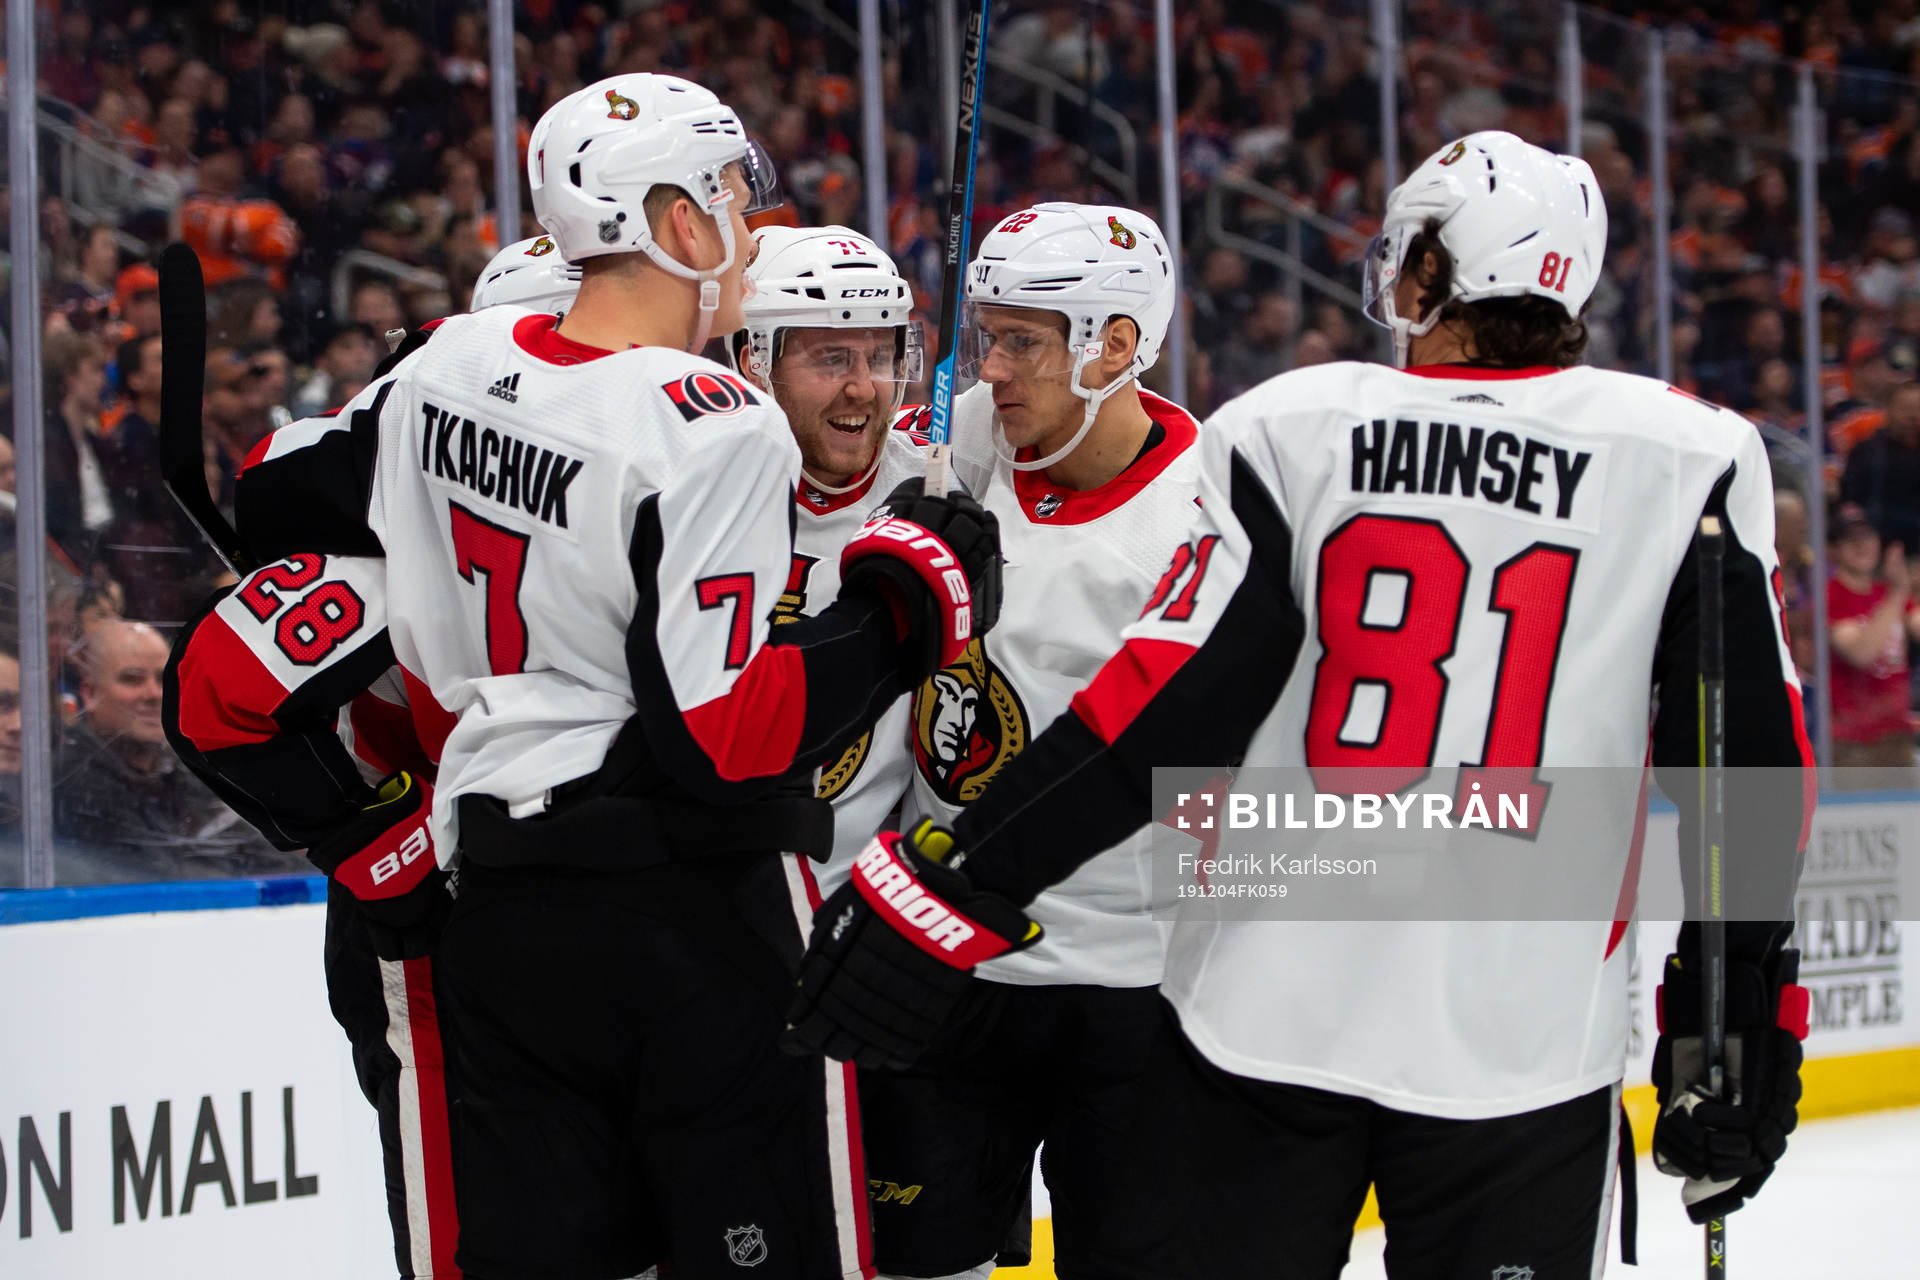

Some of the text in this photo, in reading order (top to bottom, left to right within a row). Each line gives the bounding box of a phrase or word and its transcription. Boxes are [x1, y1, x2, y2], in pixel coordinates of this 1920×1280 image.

[960, 9, 981, 132] NEXUS
[947, 214, 962, 265] TKACHUK
[998, 213, 1038, 233] 22
[1538, 251, 1573, 293] 81
[841, 288, 889, 298] CCM
[487, 386, 519, 404] adidas
[422, 401, 584, 529] TKACHUK
[1351, 419, 1592, 519] HAINSEY
[235, 552, 366, 667] 28
[448, 498, 531, 676] 7
[695, 572, 755, 671] 7
[1305, 512, 1581, 842] 81
[0, 1086, 319, 1240] N MALL
